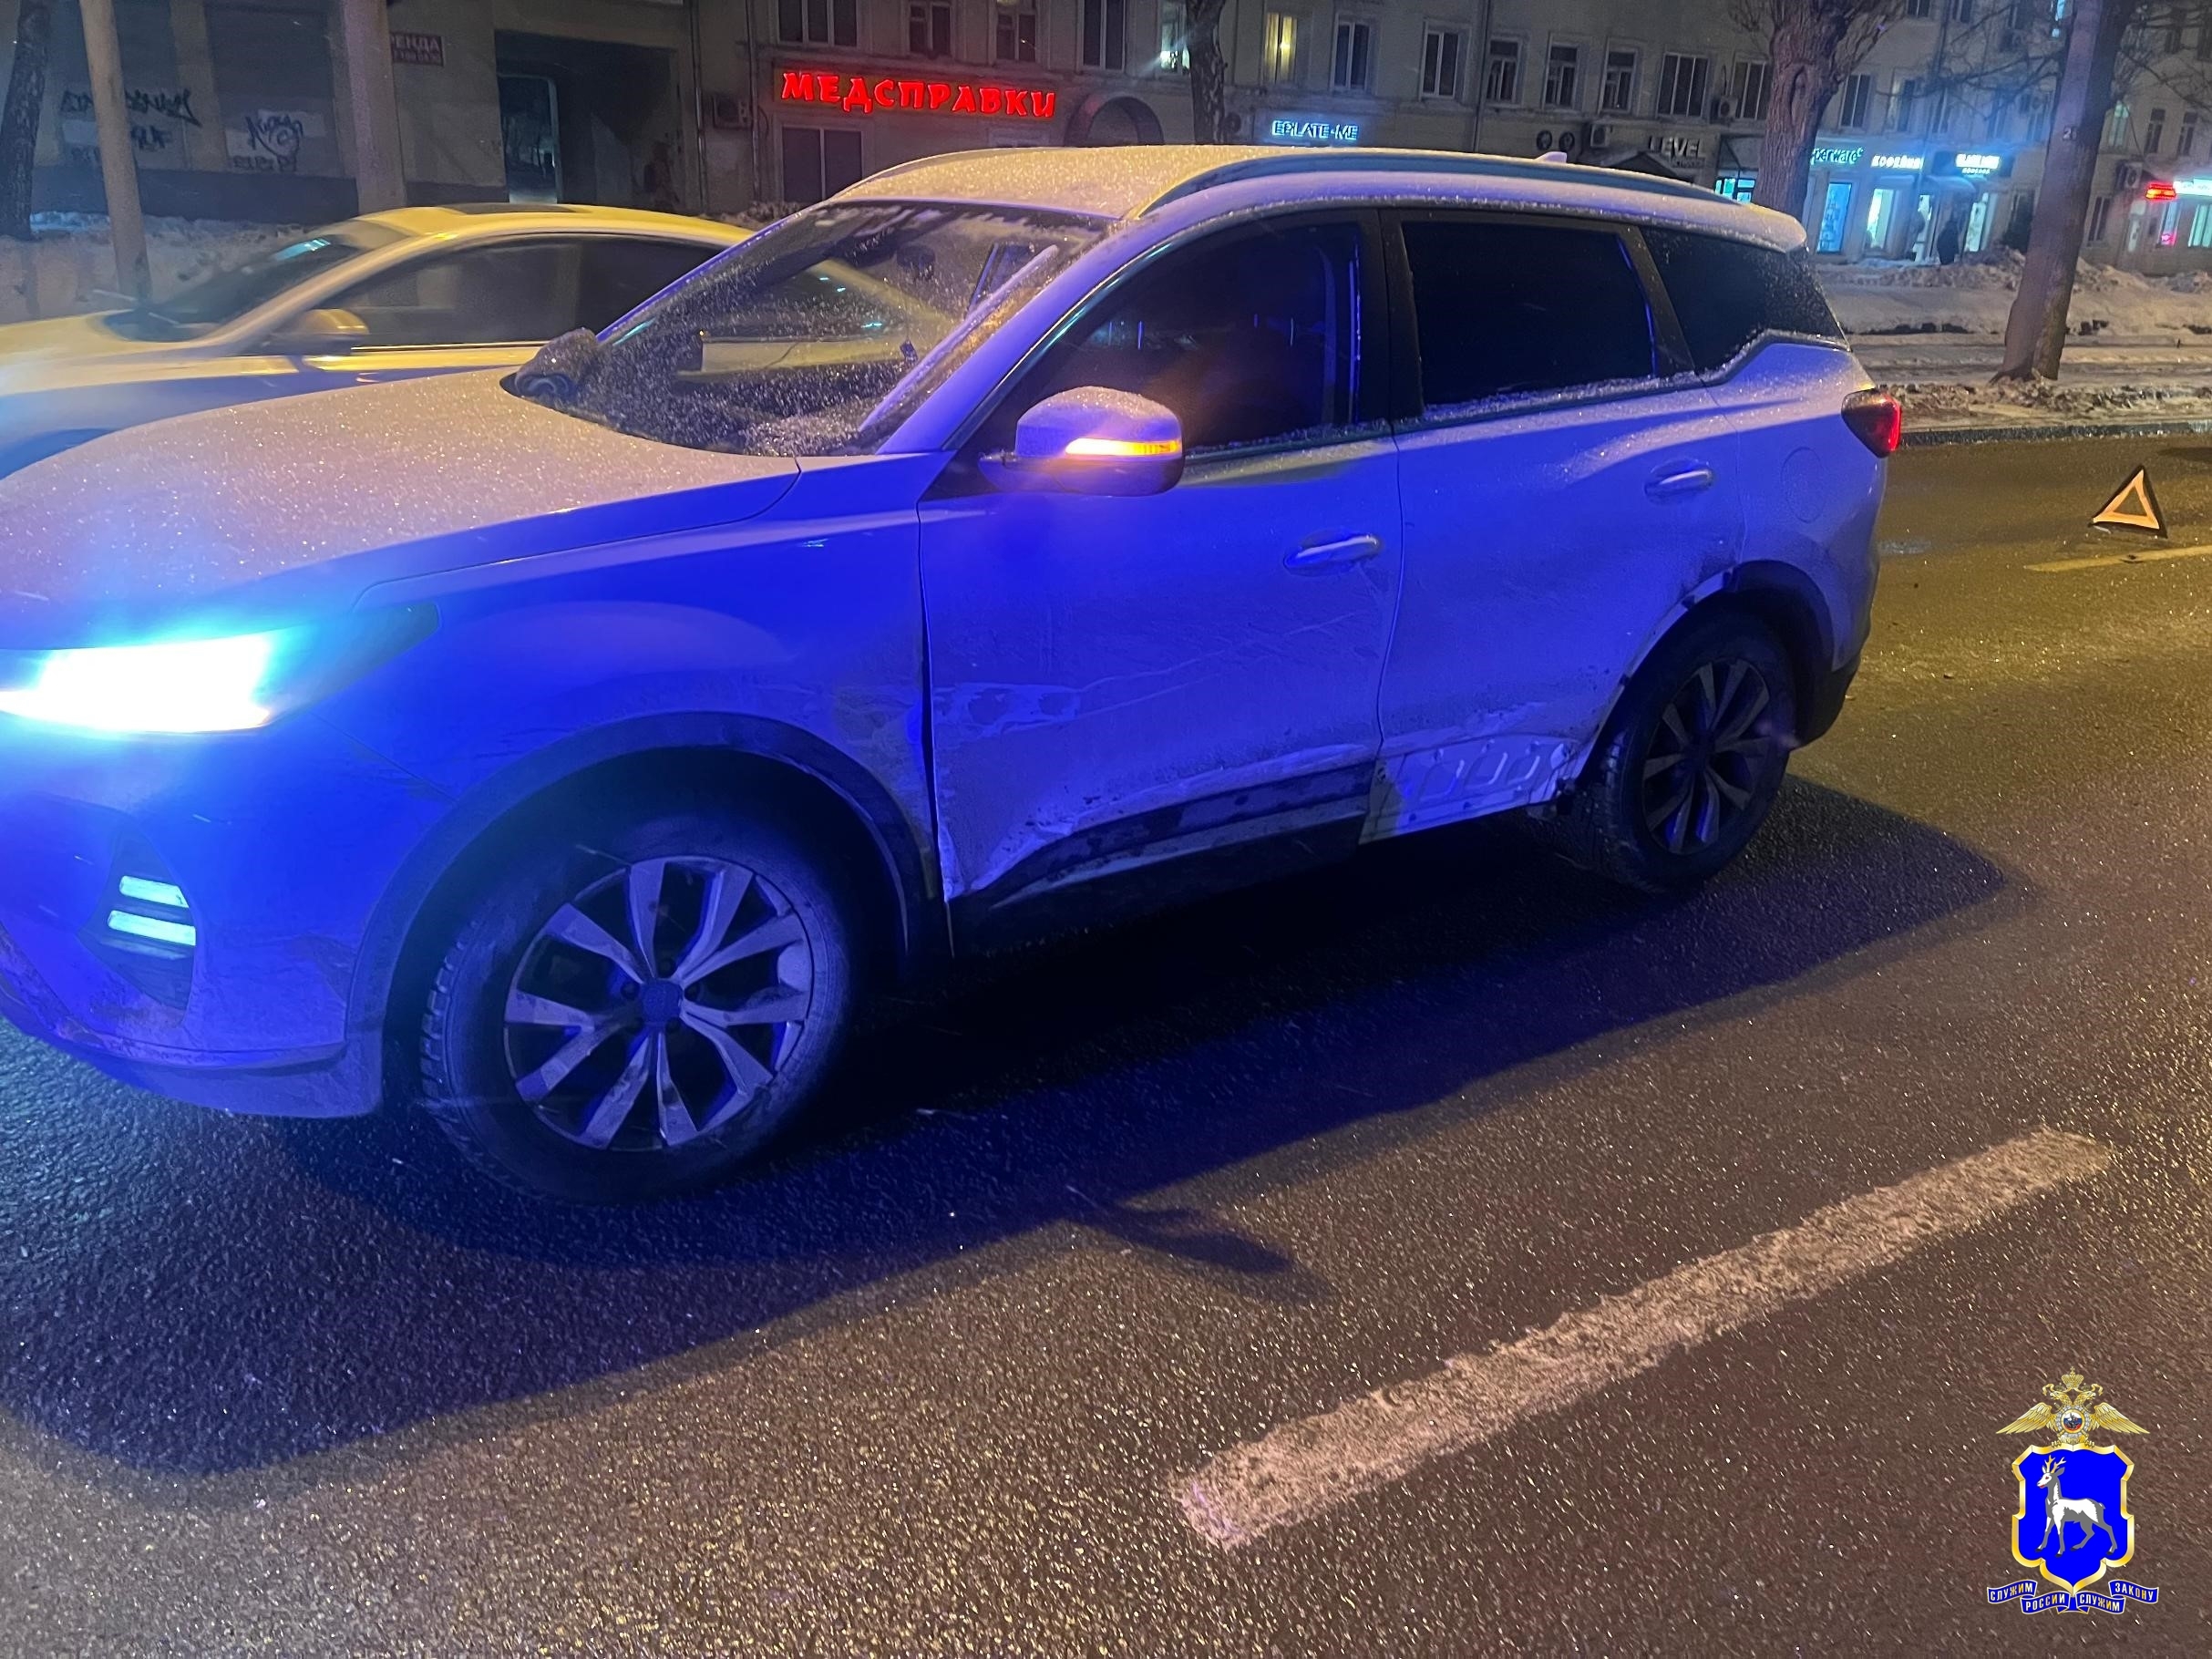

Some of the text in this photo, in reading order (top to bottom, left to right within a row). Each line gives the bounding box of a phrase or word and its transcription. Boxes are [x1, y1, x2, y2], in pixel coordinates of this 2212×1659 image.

[781, 71, 1056, 118] МЕДСПРАВКИ
[1271, 119, 1358, 140] EPILATE-ME
[1648, 136, 1706, 159] LEVEL
